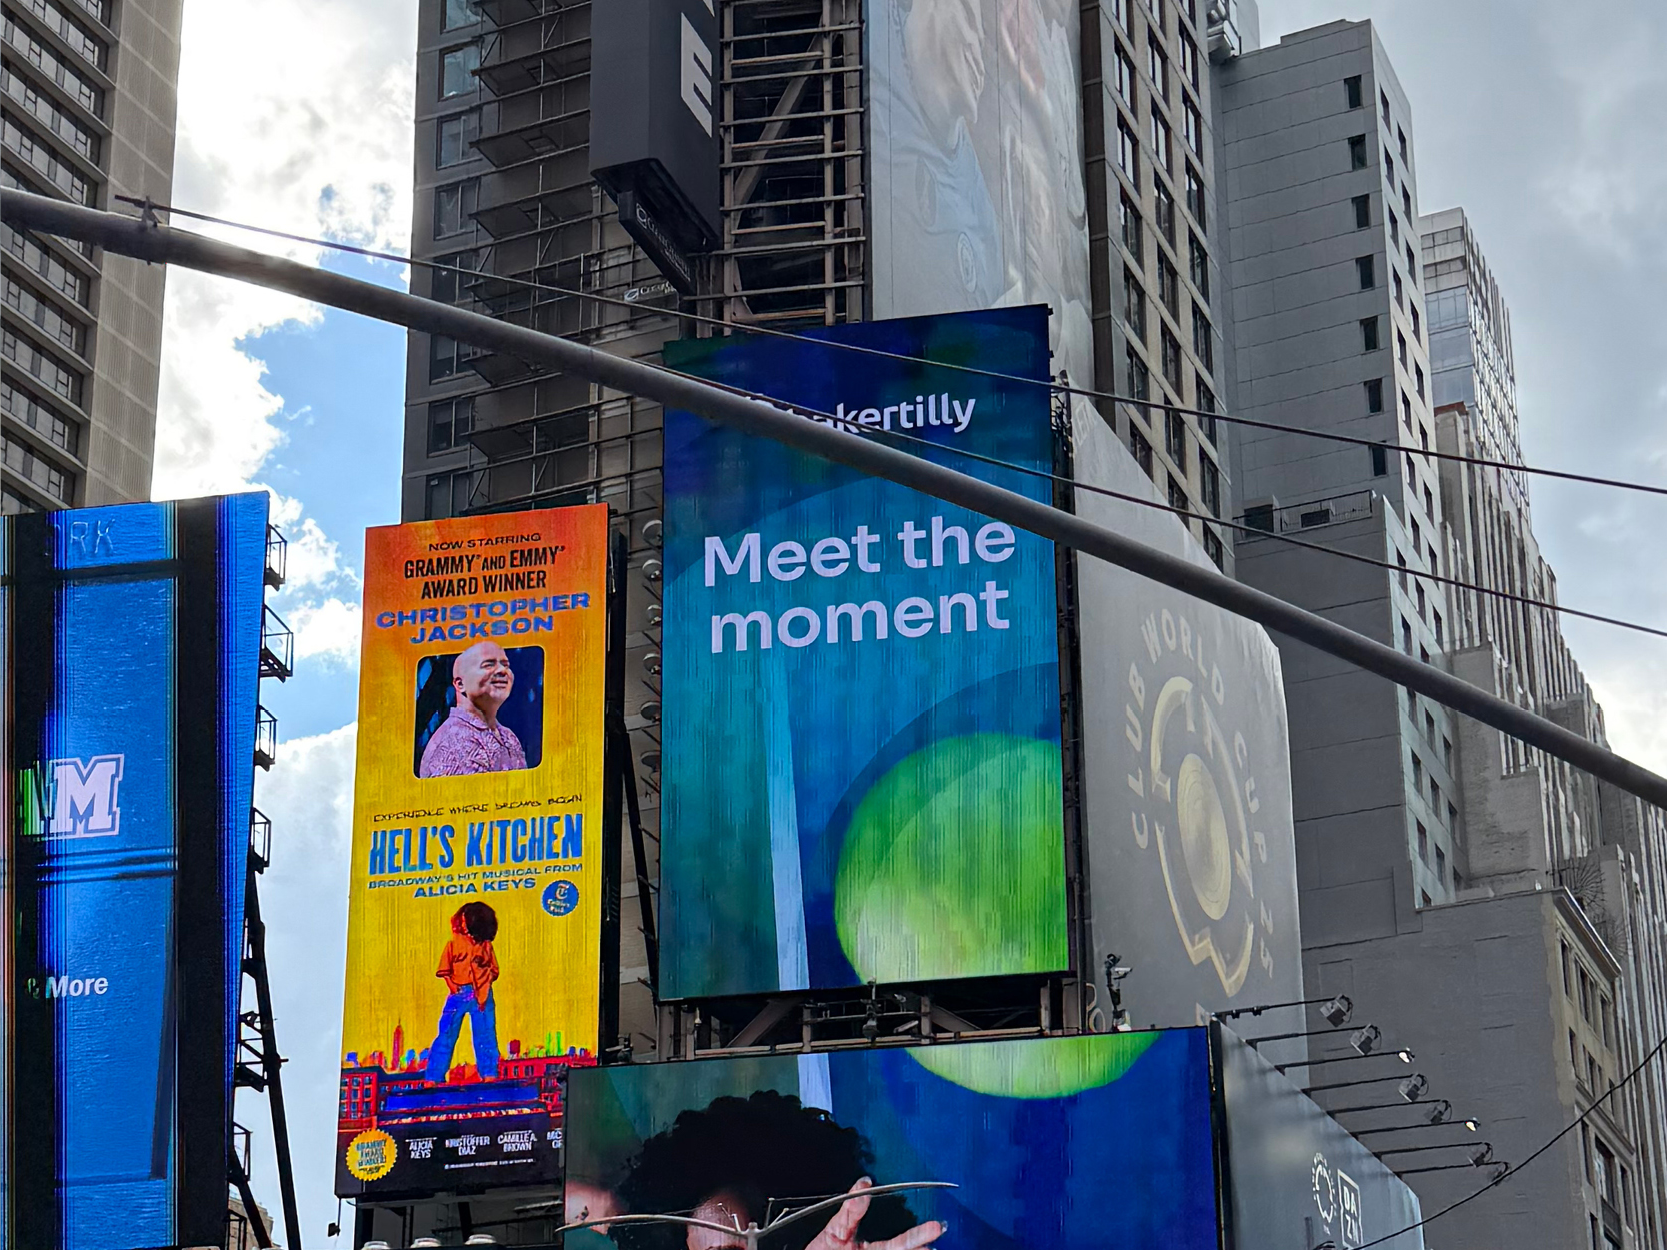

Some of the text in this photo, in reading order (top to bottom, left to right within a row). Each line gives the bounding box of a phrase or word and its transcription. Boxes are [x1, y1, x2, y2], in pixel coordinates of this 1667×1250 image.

[785, 392, 976, 434] akertilly
[428, 532, 542, 552] NOW STARRING
[704, 515, 1016, 588] Meet the
[482, 555, 506, 572] AND
[420, 570, 548, 600] AWARD WINNER
[375, 592, 592, 629] CHRISTOPHER
[711, 580, 1011, 654] moment
[409, 615, 555, 645] JACKSON
[1140, 607, 1225, 706] WORLD
[449, 803, 490, 816] WHERE
[369, 813, 584, 876] HELL'S KITCHEN
[457, 871, 479, 882] HIT
[482, 867, 542, 881] MUSICAL
[544, 862, 583, 875] FROM
[413, 877, 536, 899] ALICIA KEYS
[46, 976, 110, 999] More
